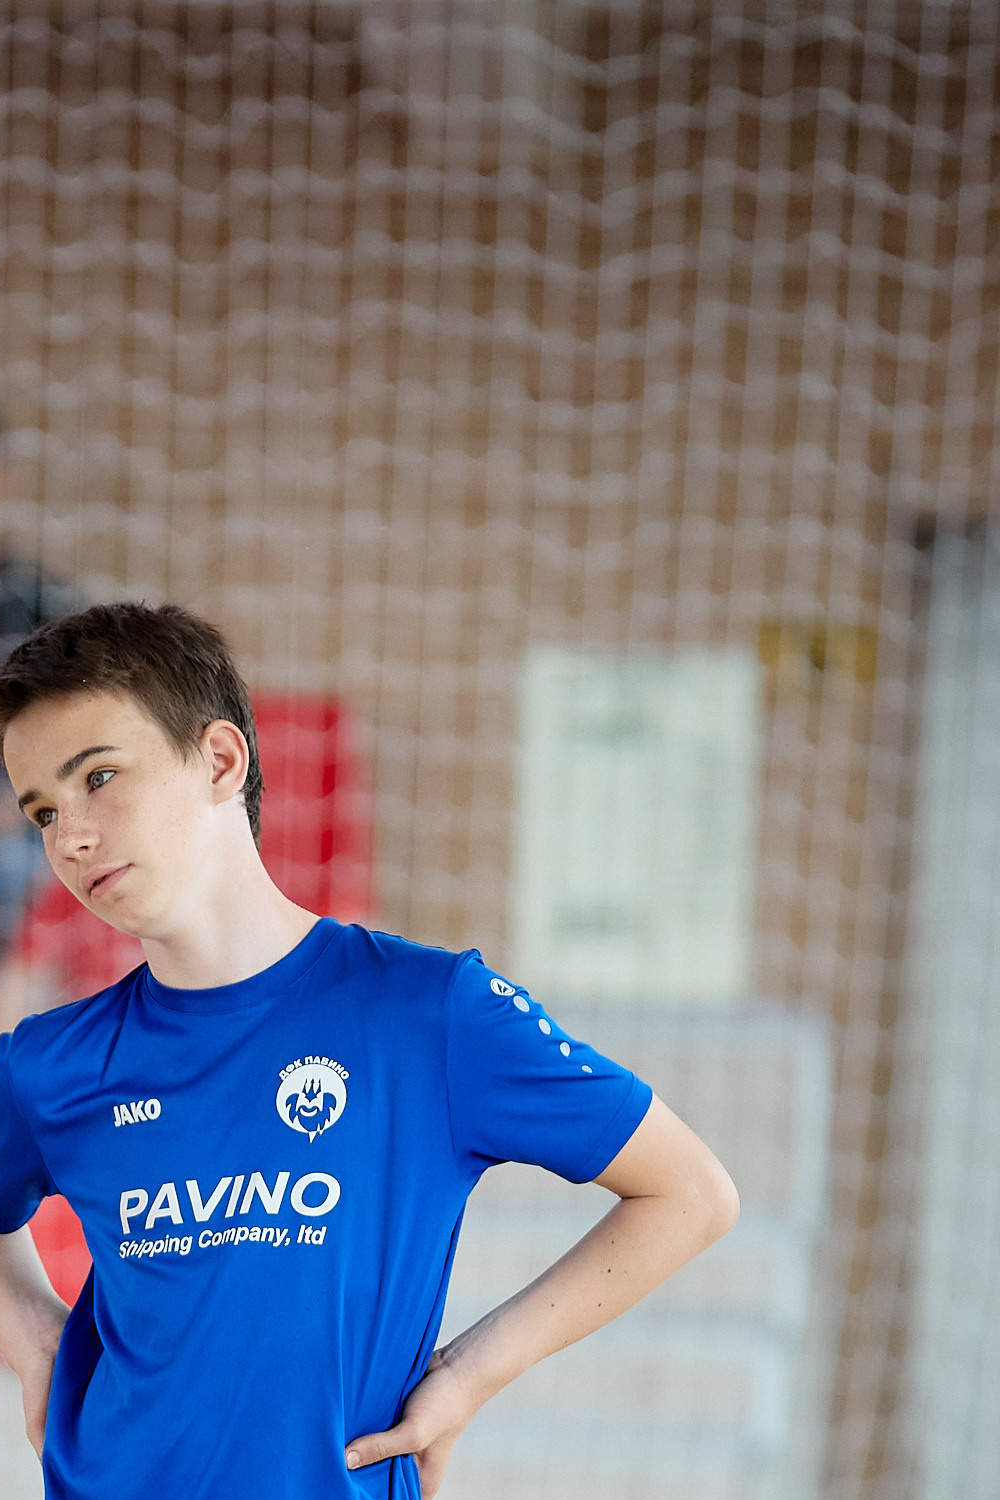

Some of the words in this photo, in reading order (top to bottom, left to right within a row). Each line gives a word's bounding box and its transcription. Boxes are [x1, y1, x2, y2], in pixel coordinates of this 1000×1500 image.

[279, 1058, 303, 1081] ДФК
[304, 1055, 350, 1080] ПАВИНО
[113, 1098, 162, 1127] JAKO
[119, 1171, 341, 1235] PAVINO
[118, 1234, 193, 1259] Shipping
[199, 1226, 292, 1249] Company,
[297, 1224, 328, 1245] ltd
